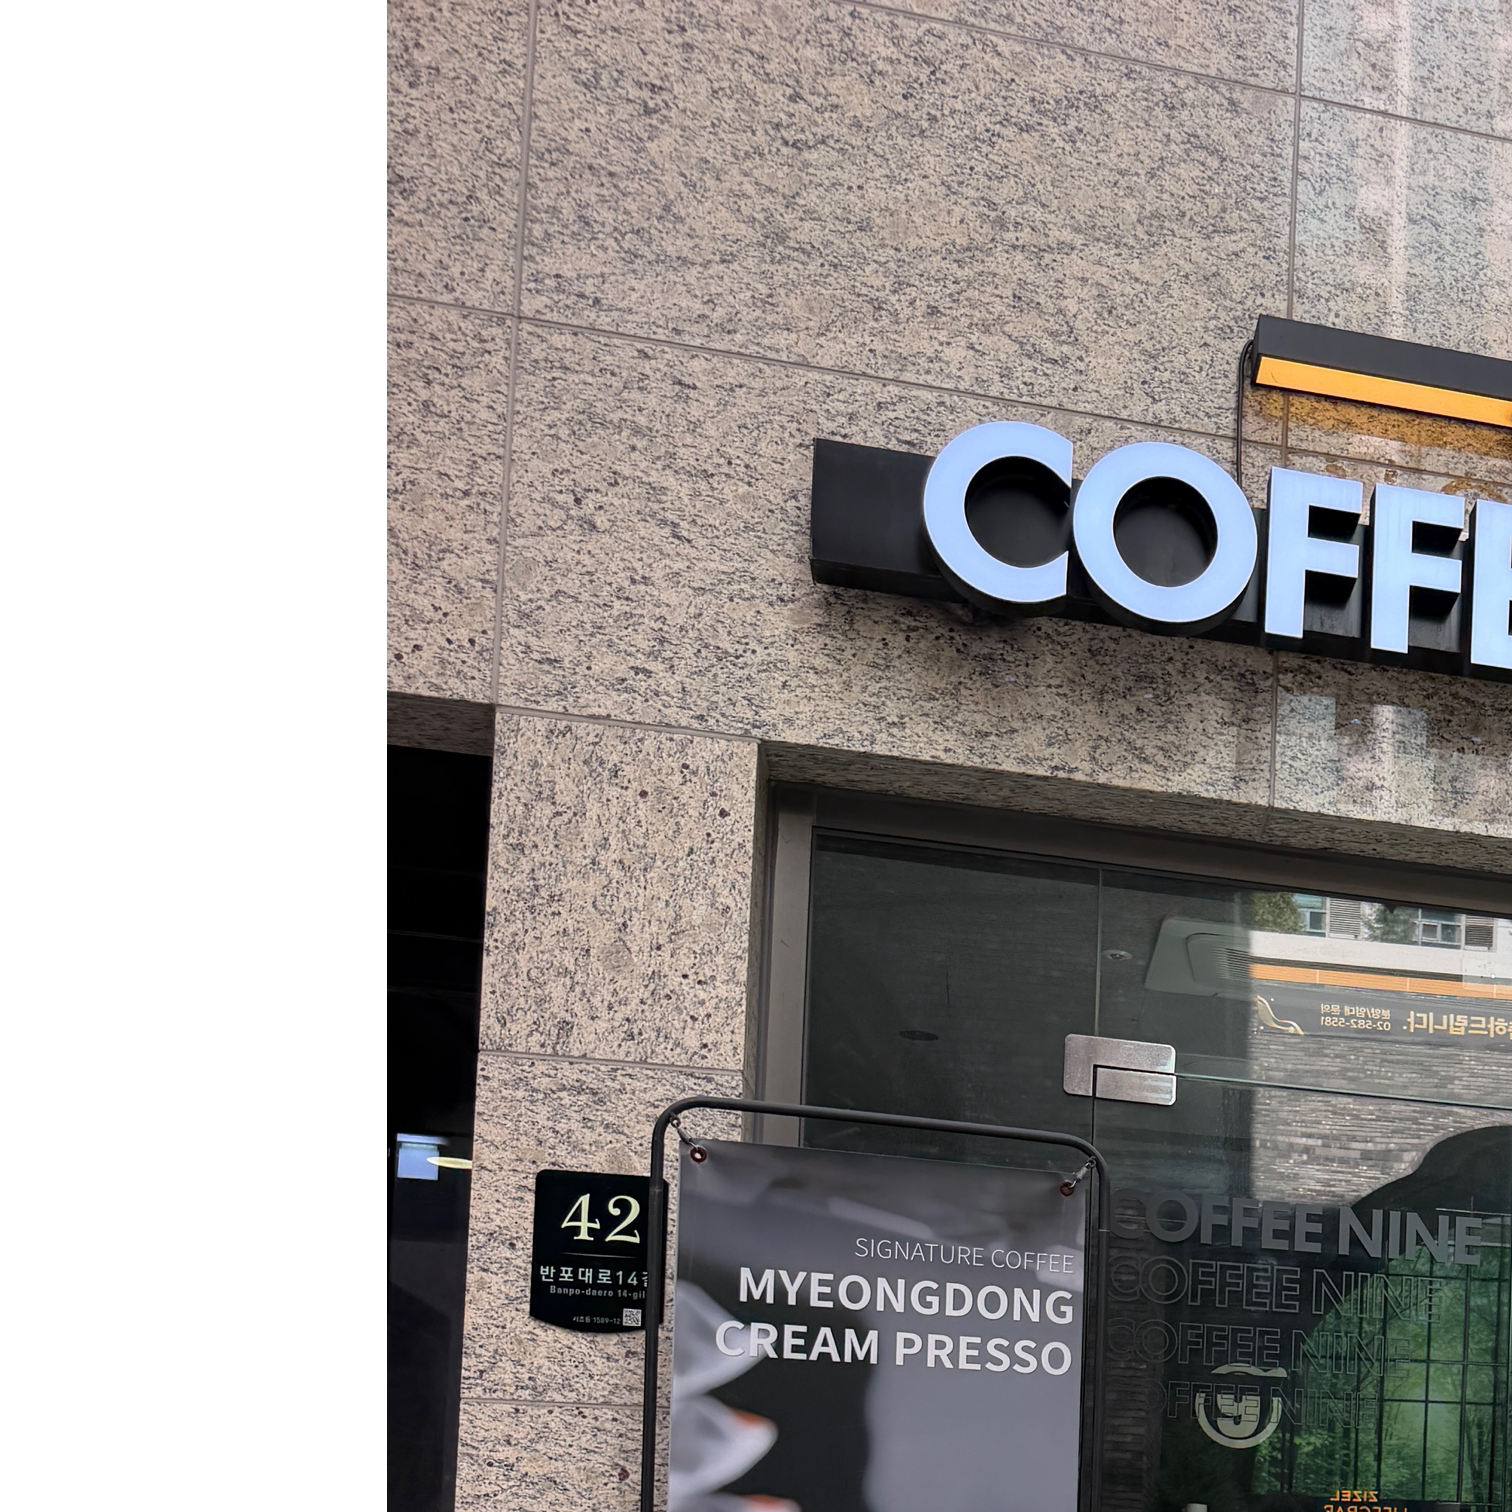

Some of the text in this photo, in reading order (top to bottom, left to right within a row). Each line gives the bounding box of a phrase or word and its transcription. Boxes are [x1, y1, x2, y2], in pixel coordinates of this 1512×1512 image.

[561, 1193, 641, 1244] 42
[1109, 1187, 1483, 1267] COFFEE NINE
[854, 1236, 1075, 1275] SIGNATURE COFFEE
[550, 1285, 646, 1299] Banpo-daero 14-gil
[738, 1266, 1075, 1326] MYEONGDONG
[1109, 1254, 1443, 1324] COFFEE NINE
[715, 1319, 1073, 1377] CREAM PRESSO
[1108, 1317, 1411, 1378] COFFEE NINE
[1144, 1378, 1261, 1423] OFFEE
